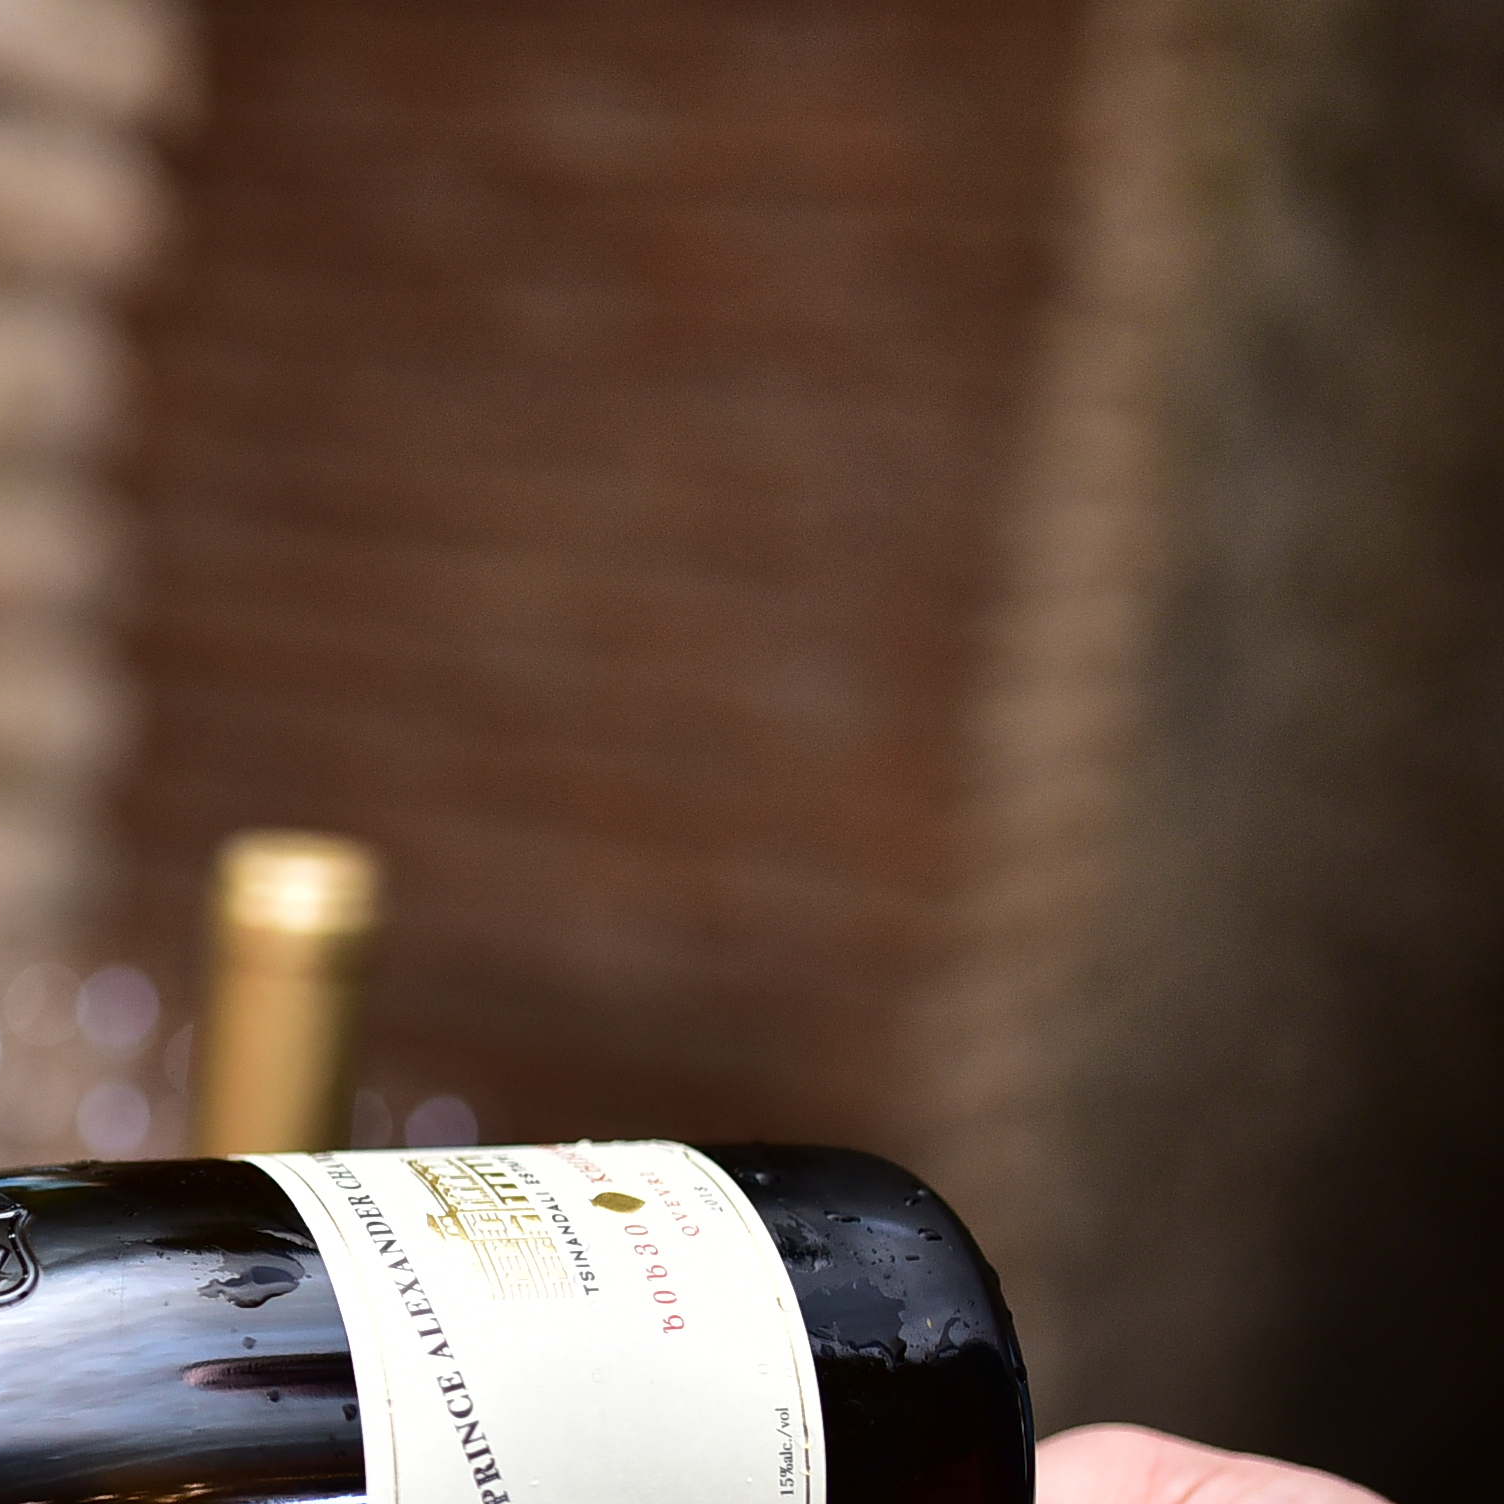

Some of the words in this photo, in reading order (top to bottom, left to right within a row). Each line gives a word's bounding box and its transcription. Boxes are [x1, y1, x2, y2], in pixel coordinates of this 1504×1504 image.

[535, 1191, 600, 1296] TSINANDALI
[639, 1170, 700, 1237] QVEVRI
[347, 1194, 455, 1360] ALEXANDER
